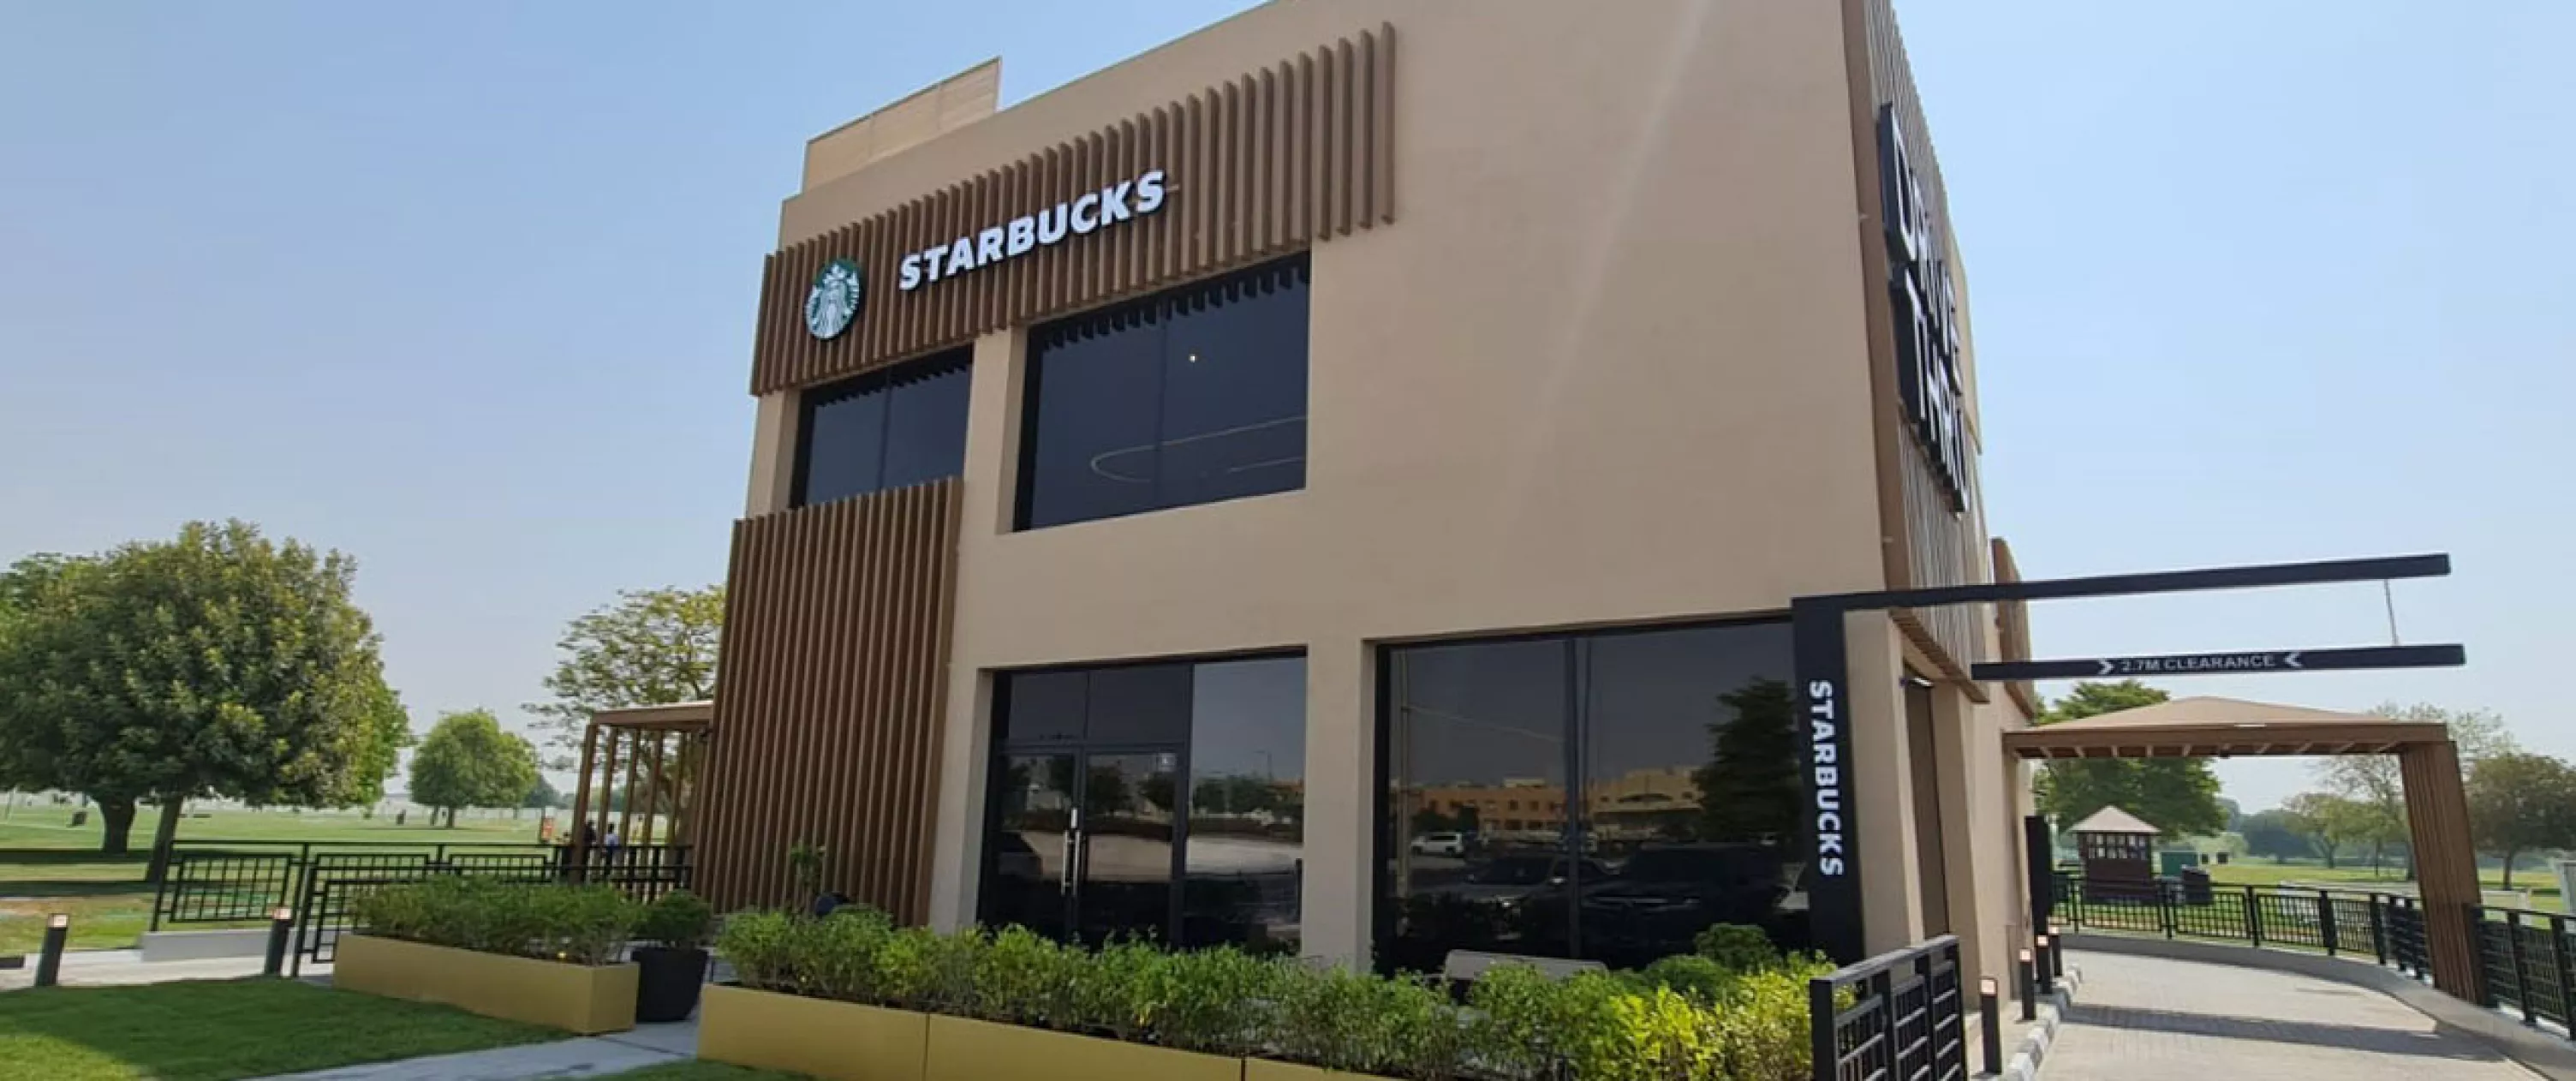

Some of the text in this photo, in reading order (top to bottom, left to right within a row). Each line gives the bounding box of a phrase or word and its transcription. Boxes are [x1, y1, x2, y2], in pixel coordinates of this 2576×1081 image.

[899, 170, 1165, 290] STARBUCKS
[1891, 107, 1963, 394] DRIVE
[1904, 267, 1968, 512] THRU
[2121, 654, 2275, 672] 2.7M CLEARANCE
[1810, 680, 1844, 875] STARBUCKS
